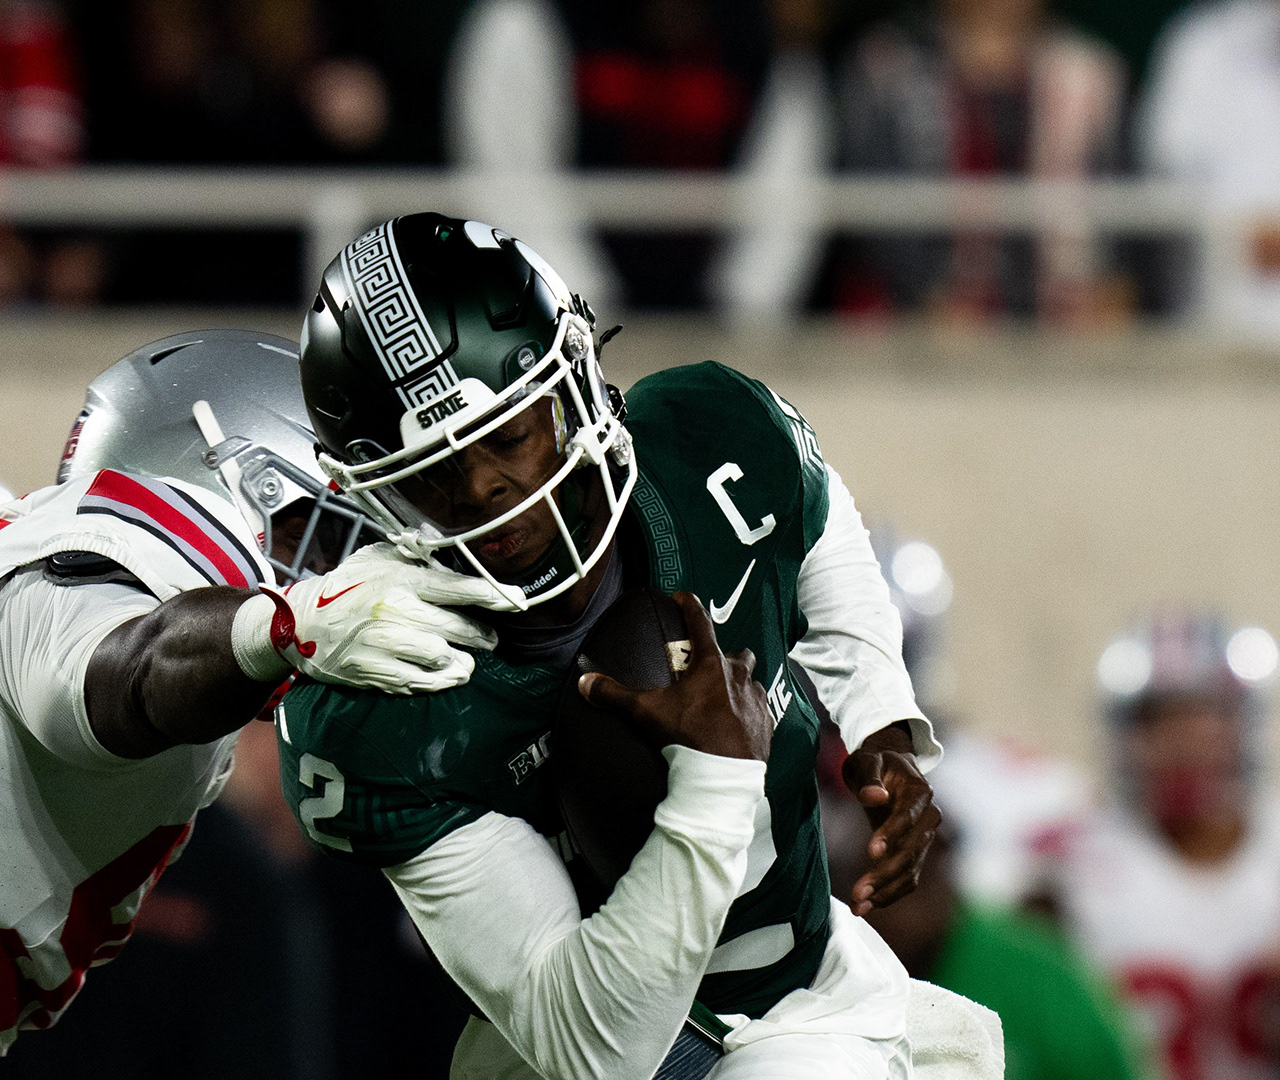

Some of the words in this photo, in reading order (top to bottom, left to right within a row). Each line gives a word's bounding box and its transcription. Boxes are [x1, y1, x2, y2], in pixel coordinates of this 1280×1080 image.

[519, 353, 536, 367] MSU
[415, 389, 469, 430] STATE
[705, 461, 776, 547] C
[522, 566, 558, 594] Riddell
[298, 751, 354, 854] 2
